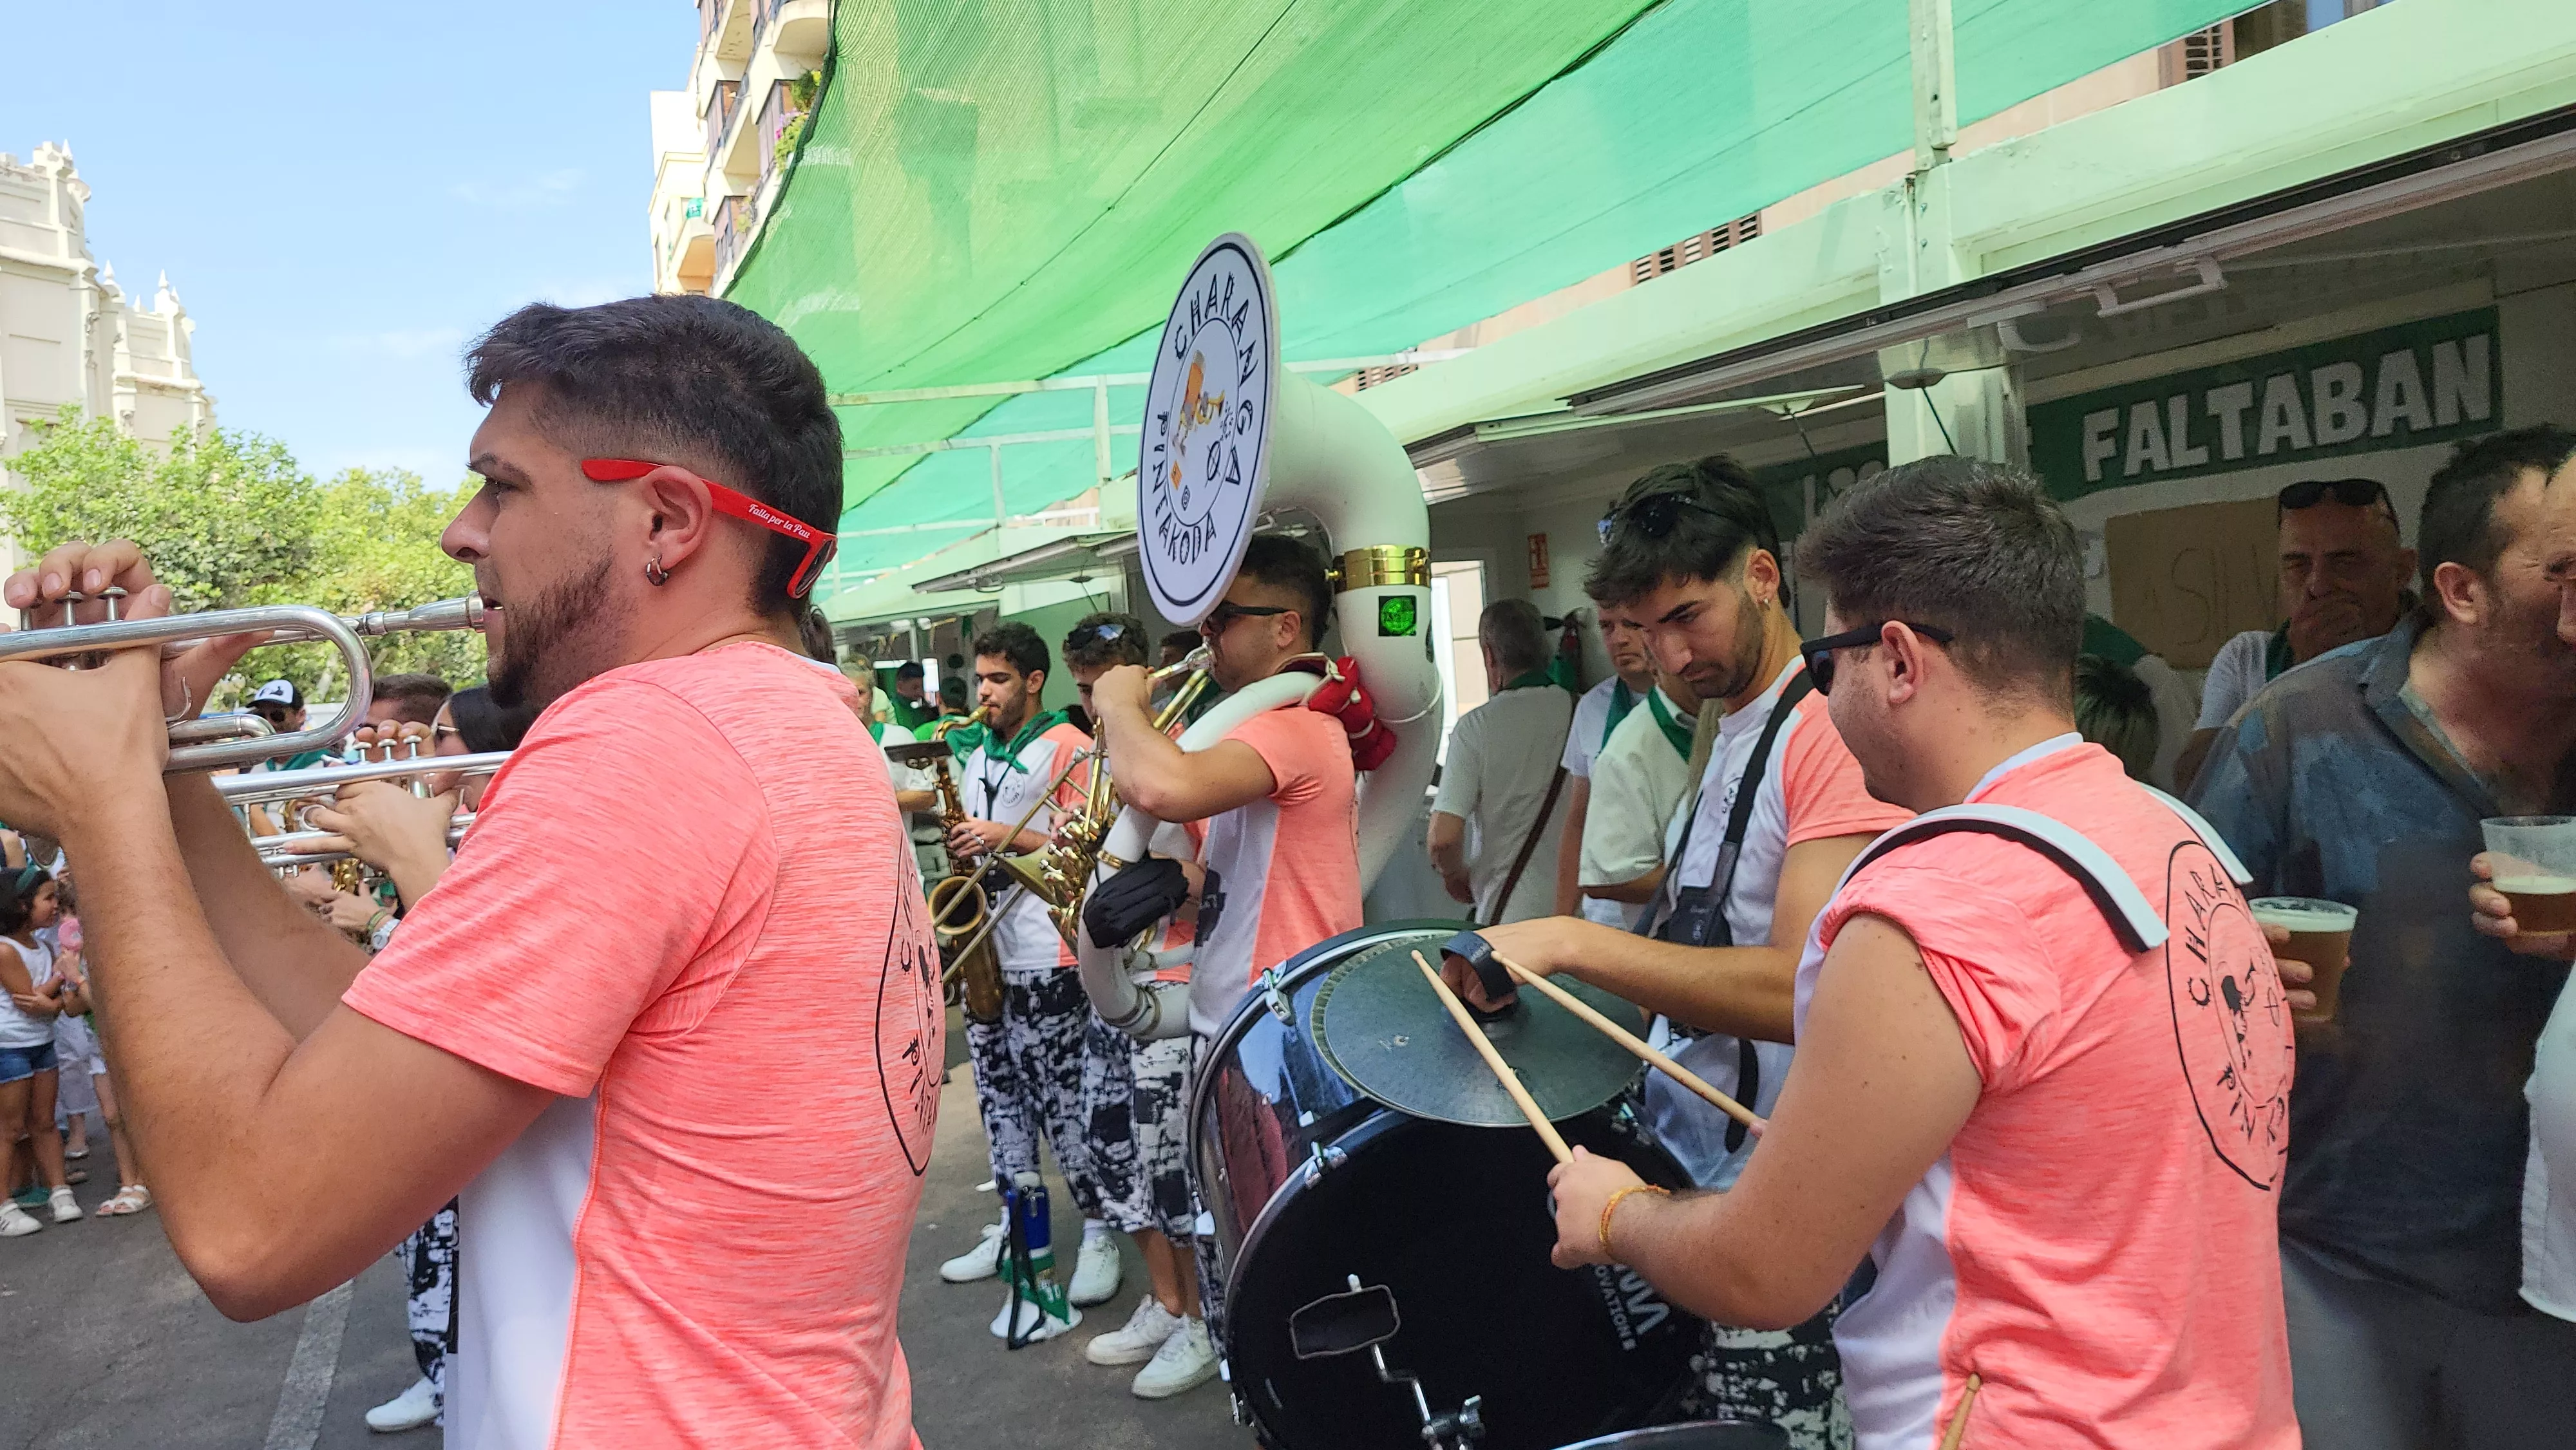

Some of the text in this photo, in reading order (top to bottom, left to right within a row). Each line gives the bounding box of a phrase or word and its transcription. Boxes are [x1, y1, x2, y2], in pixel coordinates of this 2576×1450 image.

[1174, 271, 1260, 485] CHARANGA
[2081, 333, 2492, 483] FALTABAN
[748, 504, 811, 539] Falla per la Pau
